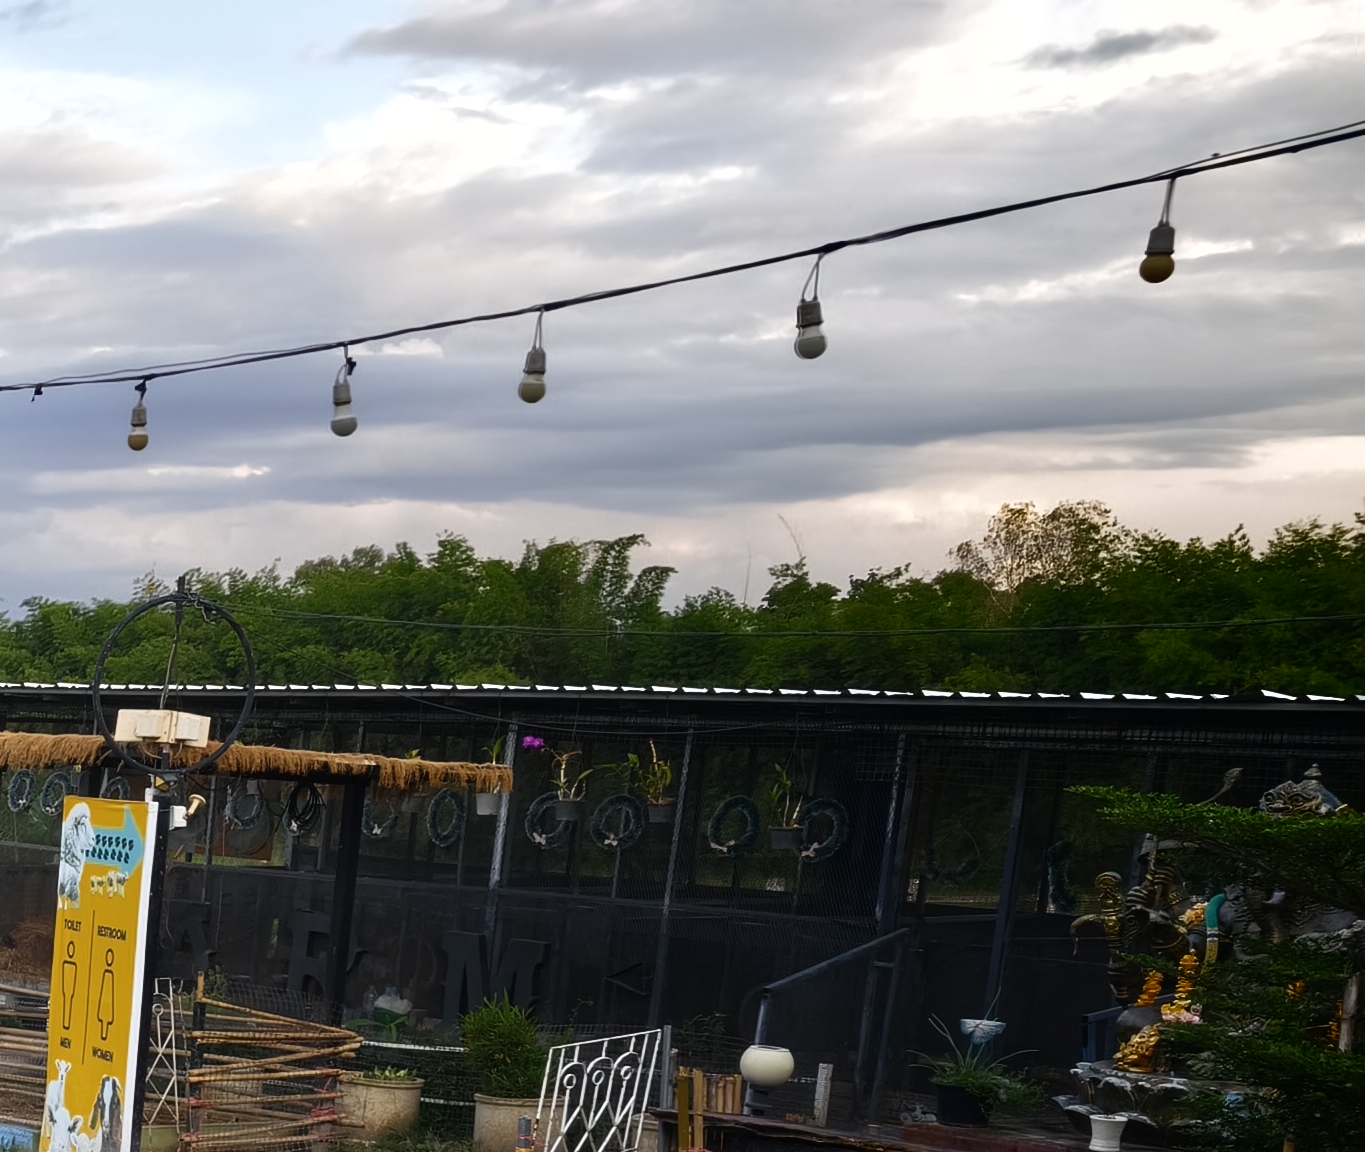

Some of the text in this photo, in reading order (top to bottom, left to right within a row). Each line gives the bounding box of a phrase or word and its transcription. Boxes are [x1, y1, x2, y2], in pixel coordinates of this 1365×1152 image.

[64, 918, 82, 933] TOILET
[97, 925, 127, 941] RESTROOM
[60, 1036, 72, 1049] MEN
[92, 1046, 114, 1063] WOMEN
